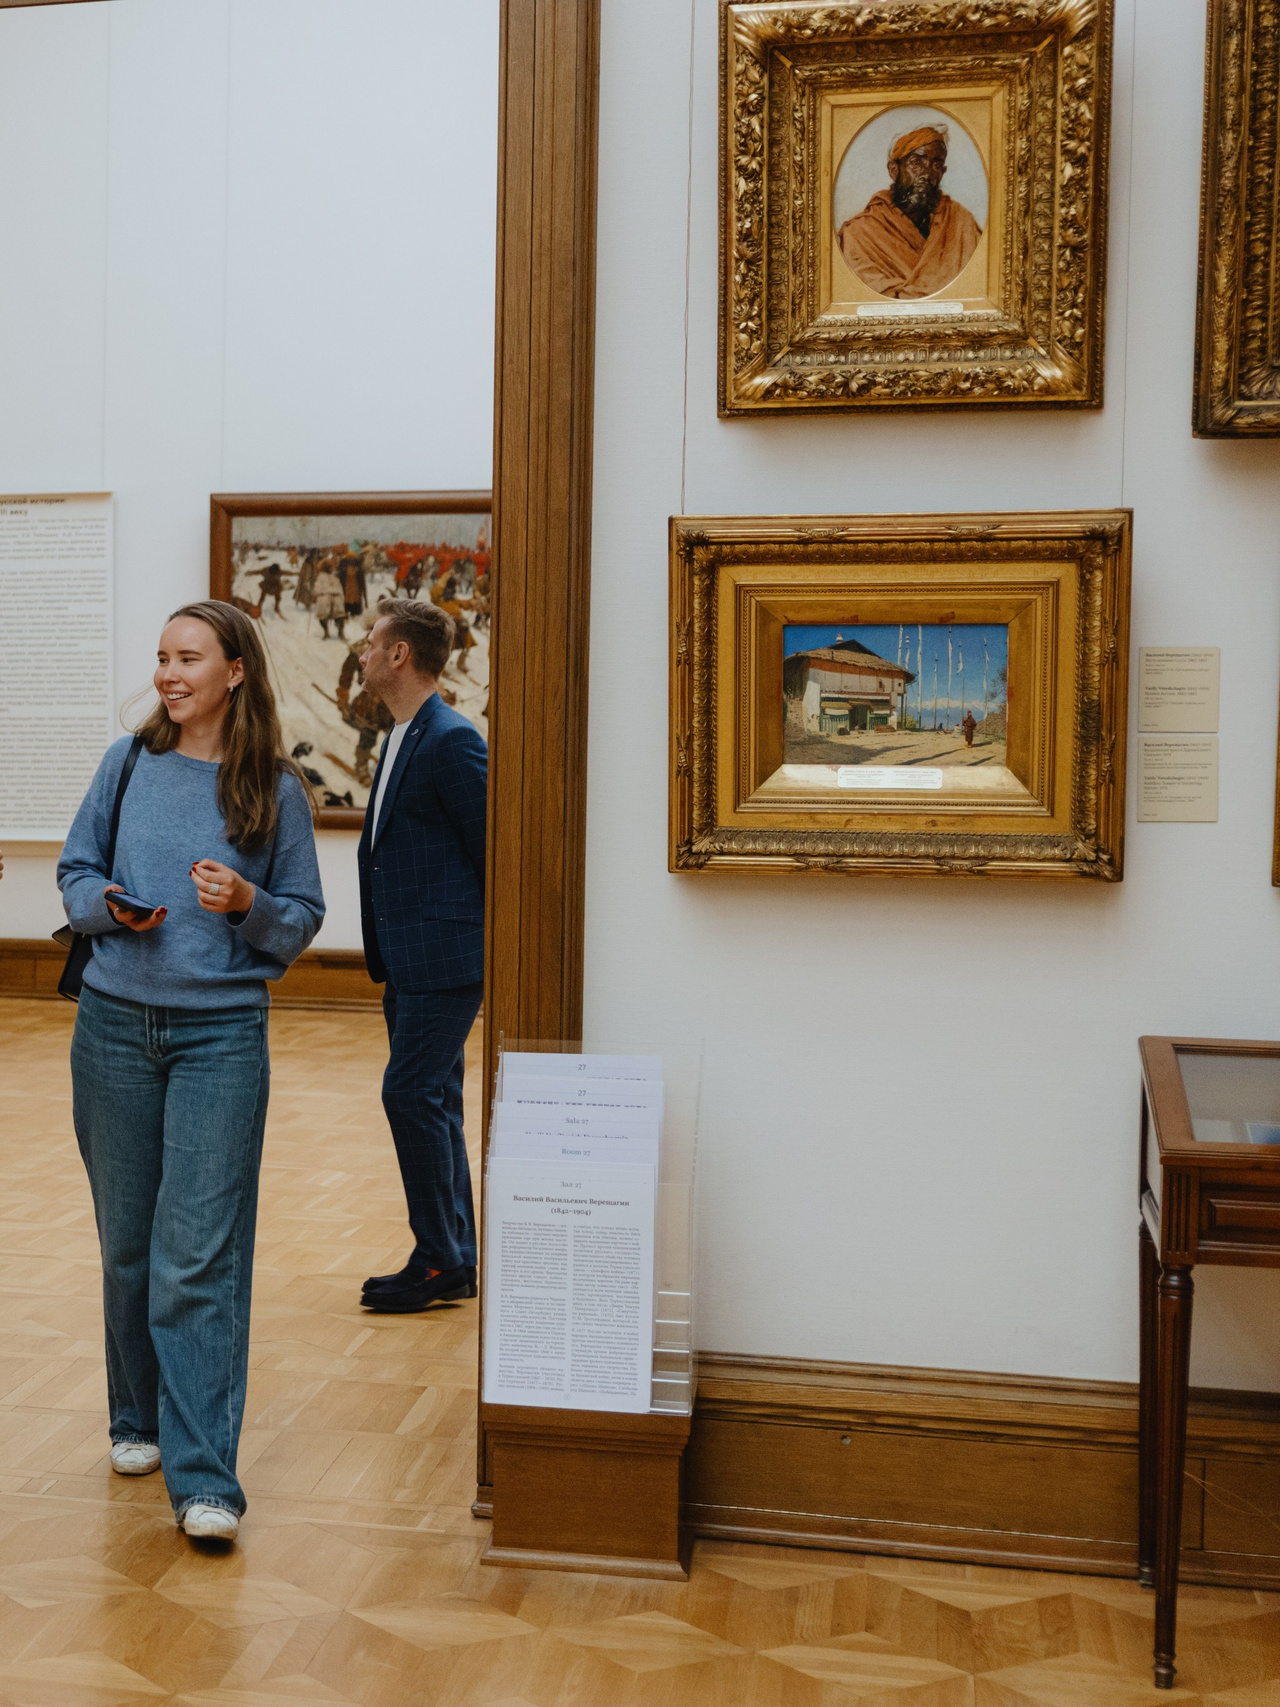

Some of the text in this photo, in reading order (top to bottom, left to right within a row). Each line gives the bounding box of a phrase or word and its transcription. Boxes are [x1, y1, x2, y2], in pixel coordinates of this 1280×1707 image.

[10, 510, 29, 518] веку
[578, 1063, 587, 1071] 27
[578, 1089, 587, 1097] 27
[561, 1148, 582, 1156] Room
[513, 1194, 630, 1207] Василий Васильевич Верещагин
